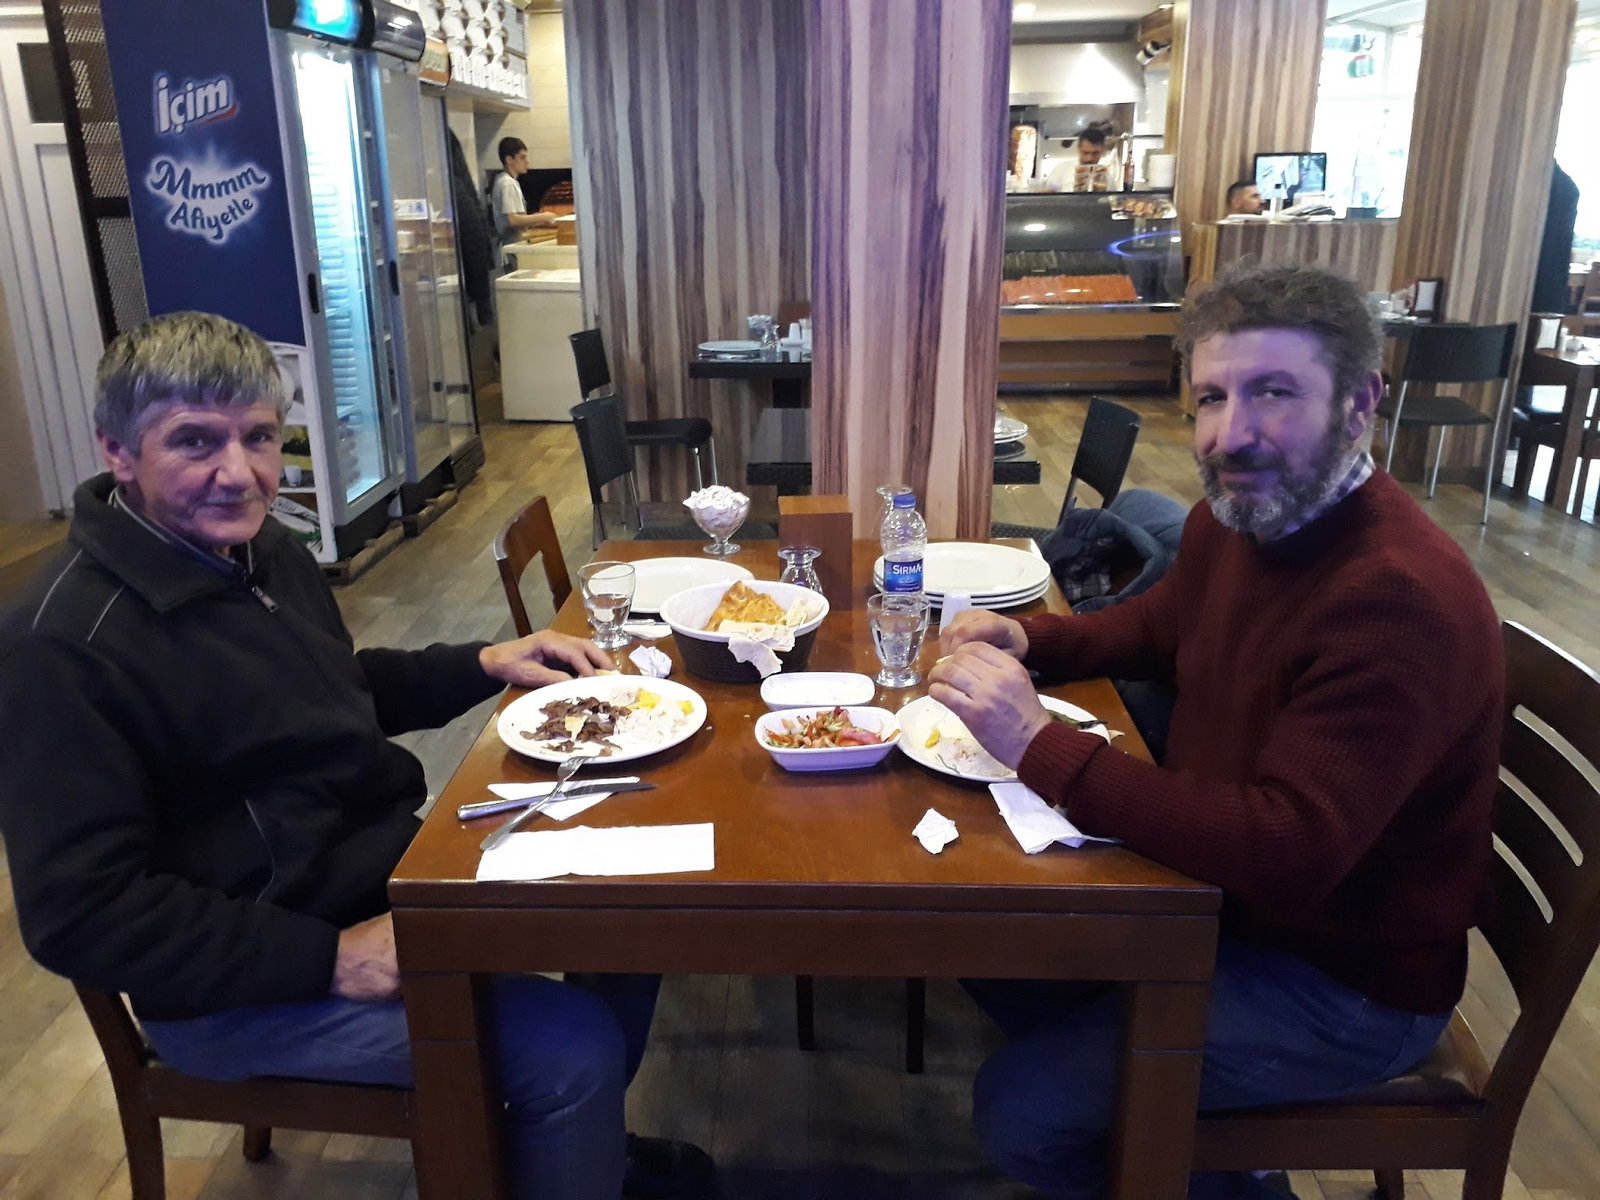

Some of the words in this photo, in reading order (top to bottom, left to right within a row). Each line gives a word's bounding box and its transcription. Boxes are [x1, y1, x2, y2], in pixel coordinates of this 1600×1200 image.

[157, 76, 230, 134] İçim
[151, 160, 266, 200] Mmmm
[170, 198, 254, 239] Afiyetle
